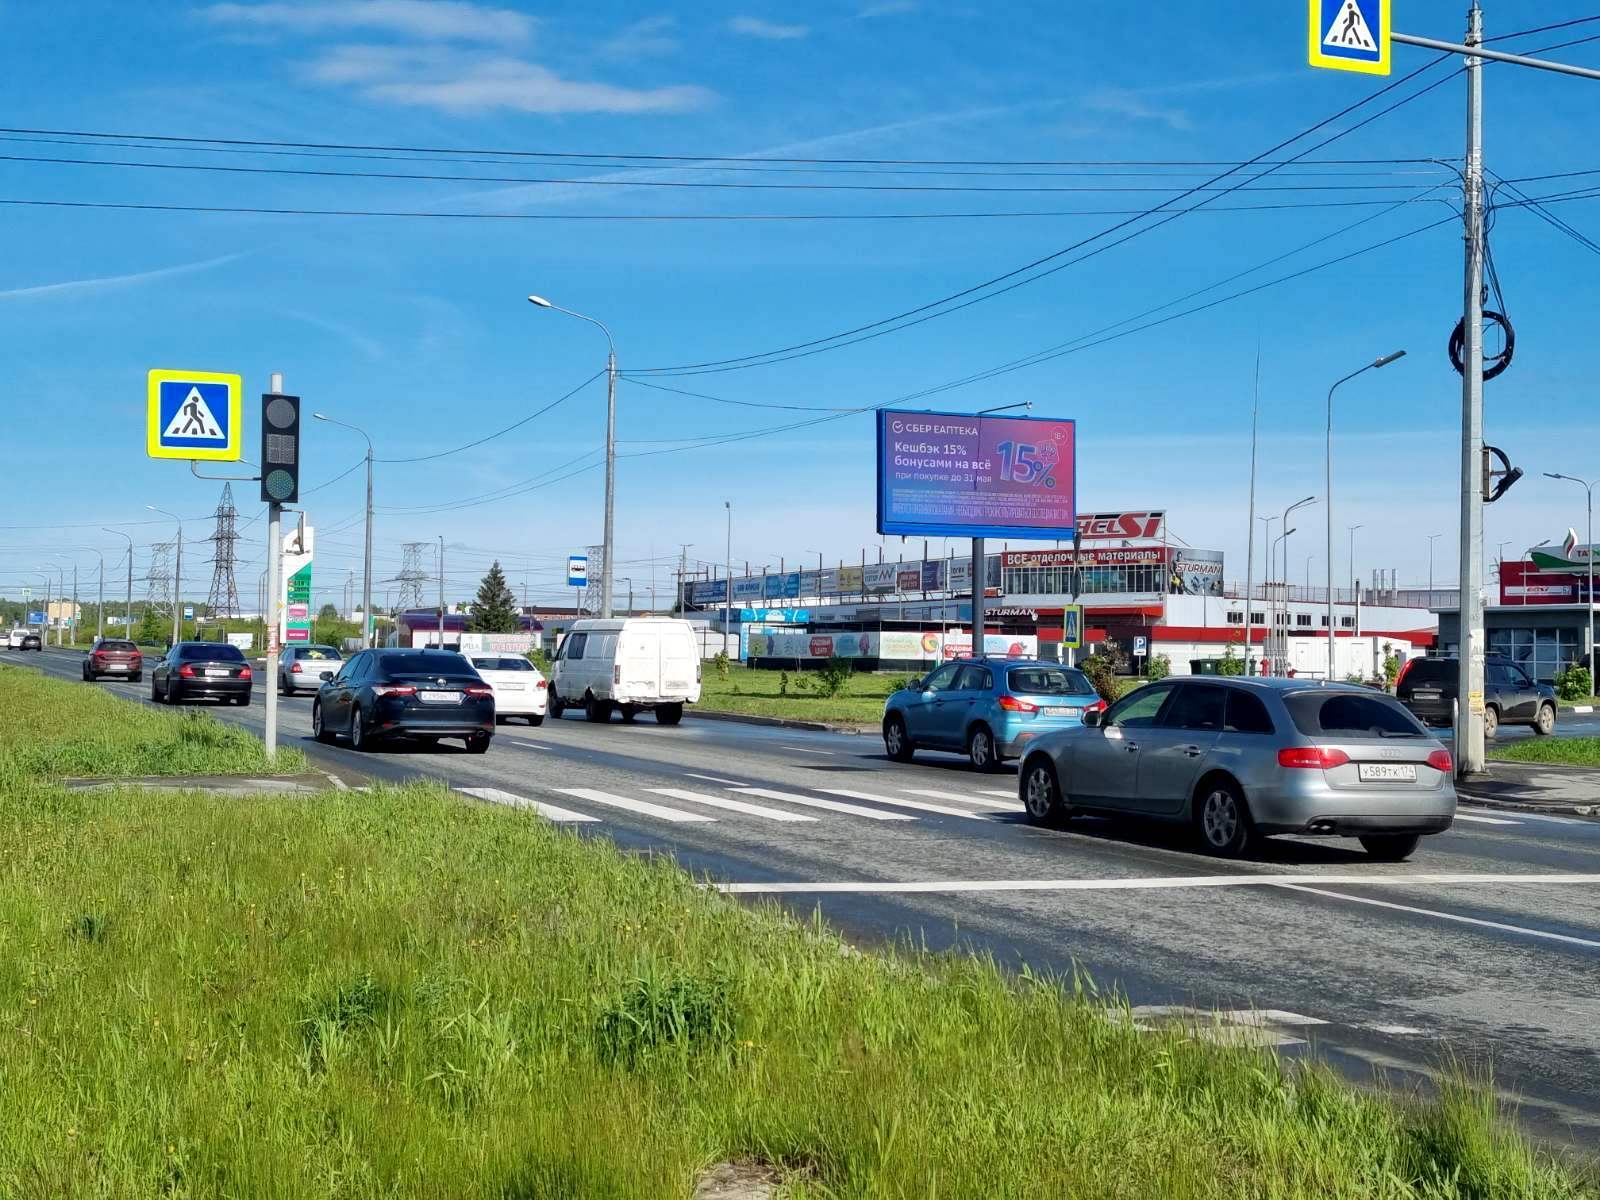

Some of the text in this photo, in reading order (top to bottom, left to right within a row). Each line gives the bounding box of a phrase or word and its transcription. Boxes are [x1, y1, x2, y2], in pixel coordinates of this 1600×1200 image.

[905, 424, 978, 435] СБЕР ЕАПТЕКА
[895, 442, 967, 456] Кешбэк 15%
[895, 455, 991, 470] бонусами на всё
[997, 440, 1056, 489] 15%
[895, 471, 912, 480] при
[914, 472, 949, 482] покупке
[951, 473, 962, 482] до
[964, 474, 974, 482] 31
[1007, 550, 1161, 566] ВСЕ отделочые материалы
[1176, 562, 1222, 575] STURMAN
